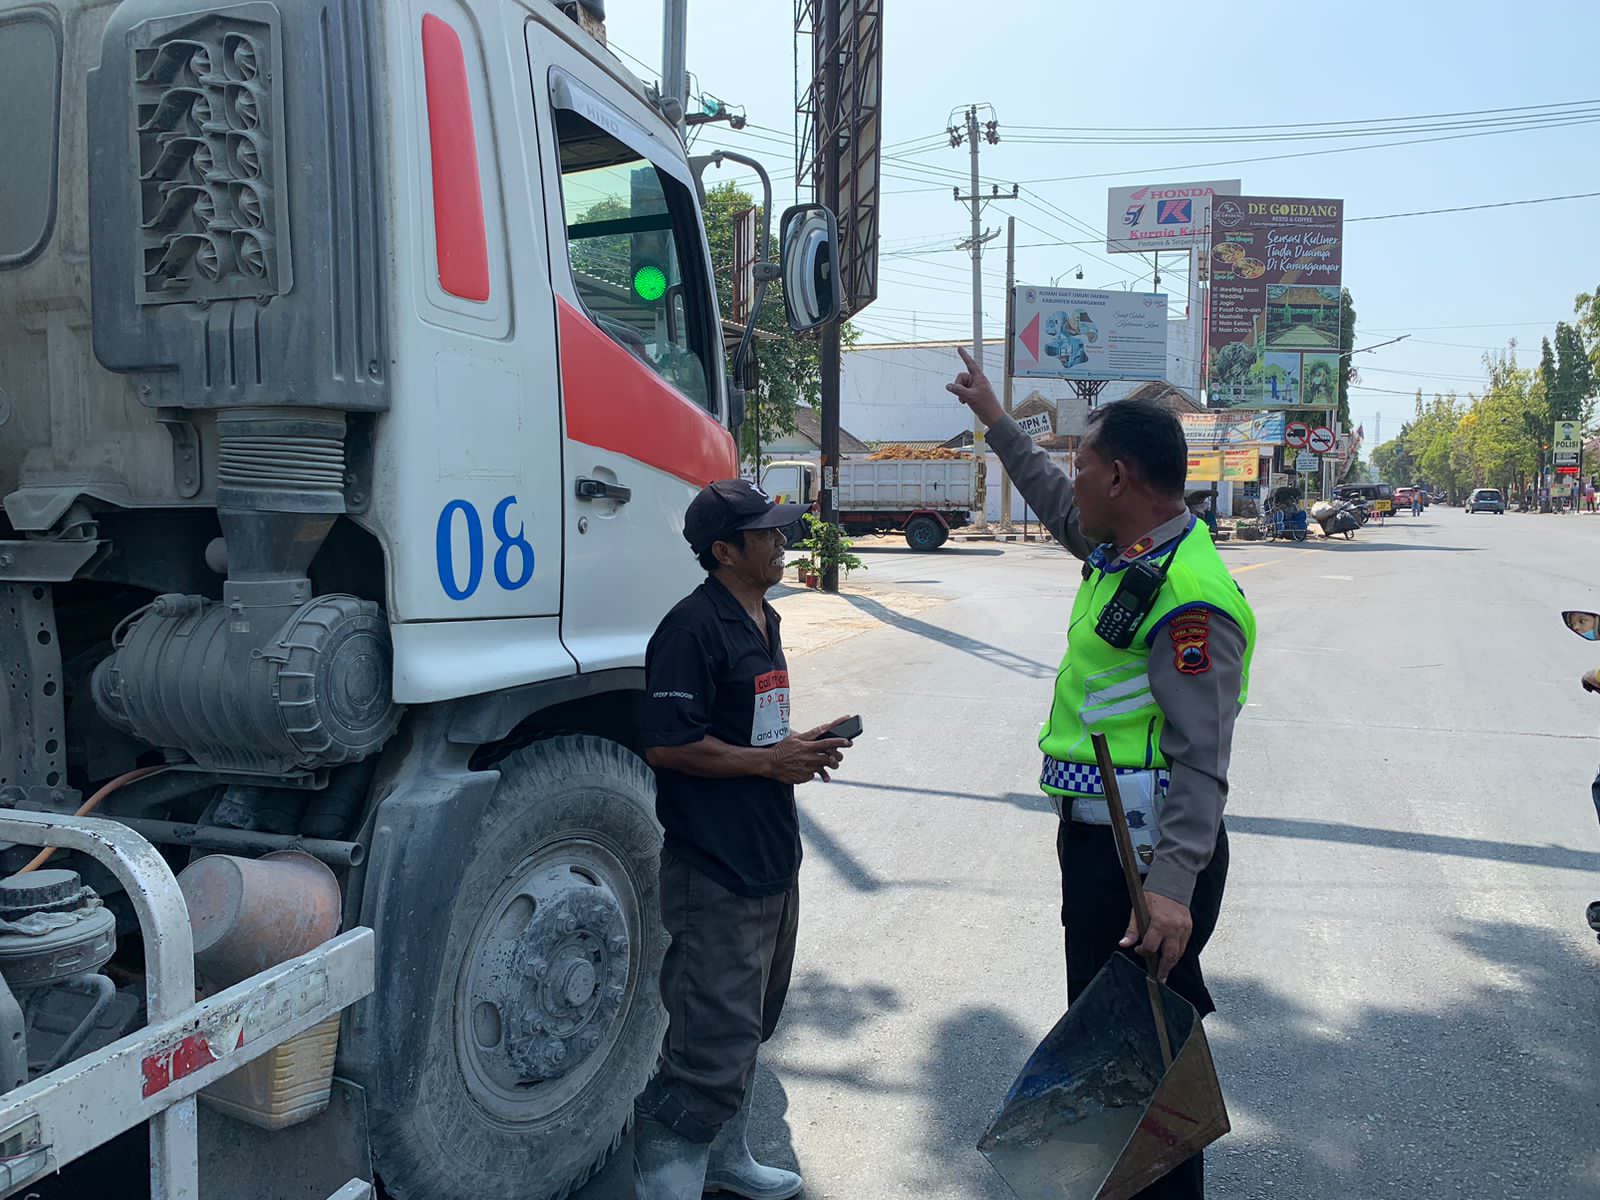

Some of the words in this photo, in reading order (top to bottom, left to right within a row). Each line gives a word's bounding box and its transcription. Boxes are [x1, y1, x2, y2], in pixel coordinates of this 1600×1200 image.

[585, 104, 620, 134] HINO
[1151, 187, 1216, 199] HONDA
[1248, 203, 1268, 214] DE
[1270, 203, 1337, 217] GOEDANG
[1267, 258, 1278, 271] Di
[1019, 417, 1041, 431] MPN
[1041, 415, 1048, 425] 4
[1556, 440, 1578, 448] POLISI
[436, 495, 535, 601] 08
[756, 729, 772, 742] and
